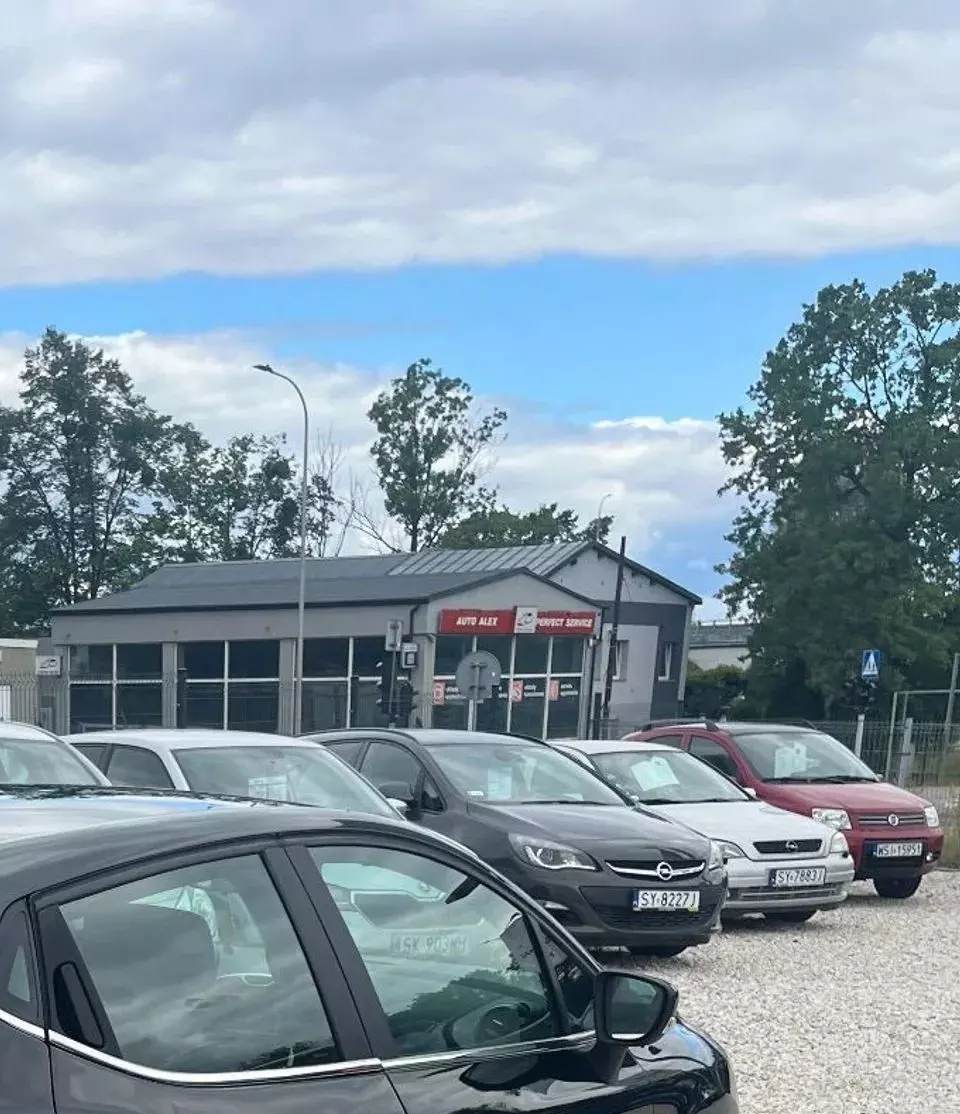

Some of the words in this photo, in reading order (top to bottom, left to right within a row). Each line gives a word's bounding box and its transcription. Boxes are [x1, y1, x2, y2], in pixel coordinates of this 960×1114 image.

[456, 617, 476, 625] AUTO
[478, 617, 498, 626] ALEX
[565, 619, 593, 627] SERVICE
[641, 892, 657, 906] SY
[660, 892, 696, 907] 8227J
